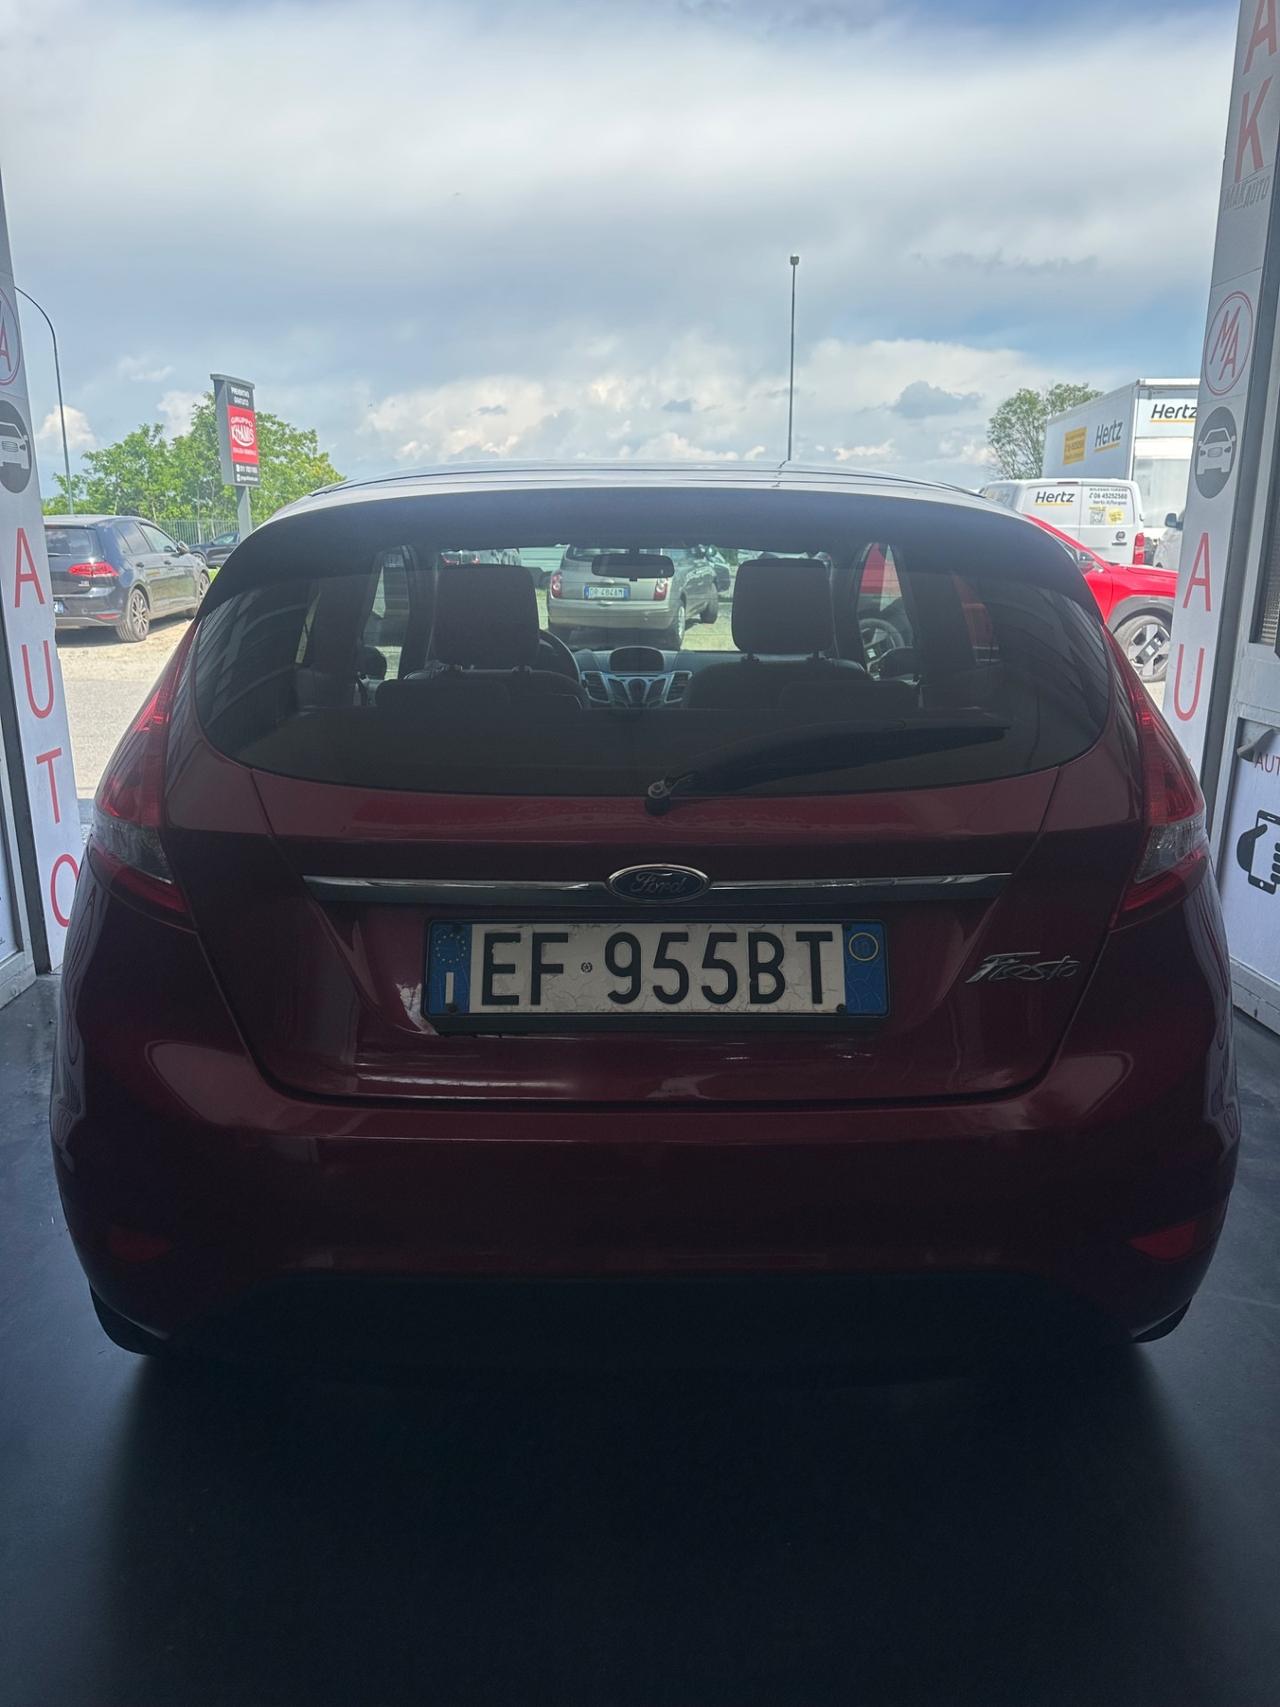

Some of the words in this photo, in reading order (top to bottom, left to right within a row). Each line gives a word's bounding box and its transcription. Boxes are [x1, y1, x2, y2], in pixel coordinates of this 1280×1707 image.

[1151, 403, 1197, 418] Hertz
[1094, 419, 1123, 448] Hertz
[1035, 491, 1075, 503] Hertz
[1173, 532, 1212, 721] AU
[630, 871, 687, 895] Ford
[481, 933, 569, 1006] EF
[604, 932, 834, 1006] 955BT
[965, 951, 1081, 984] Fiesta
